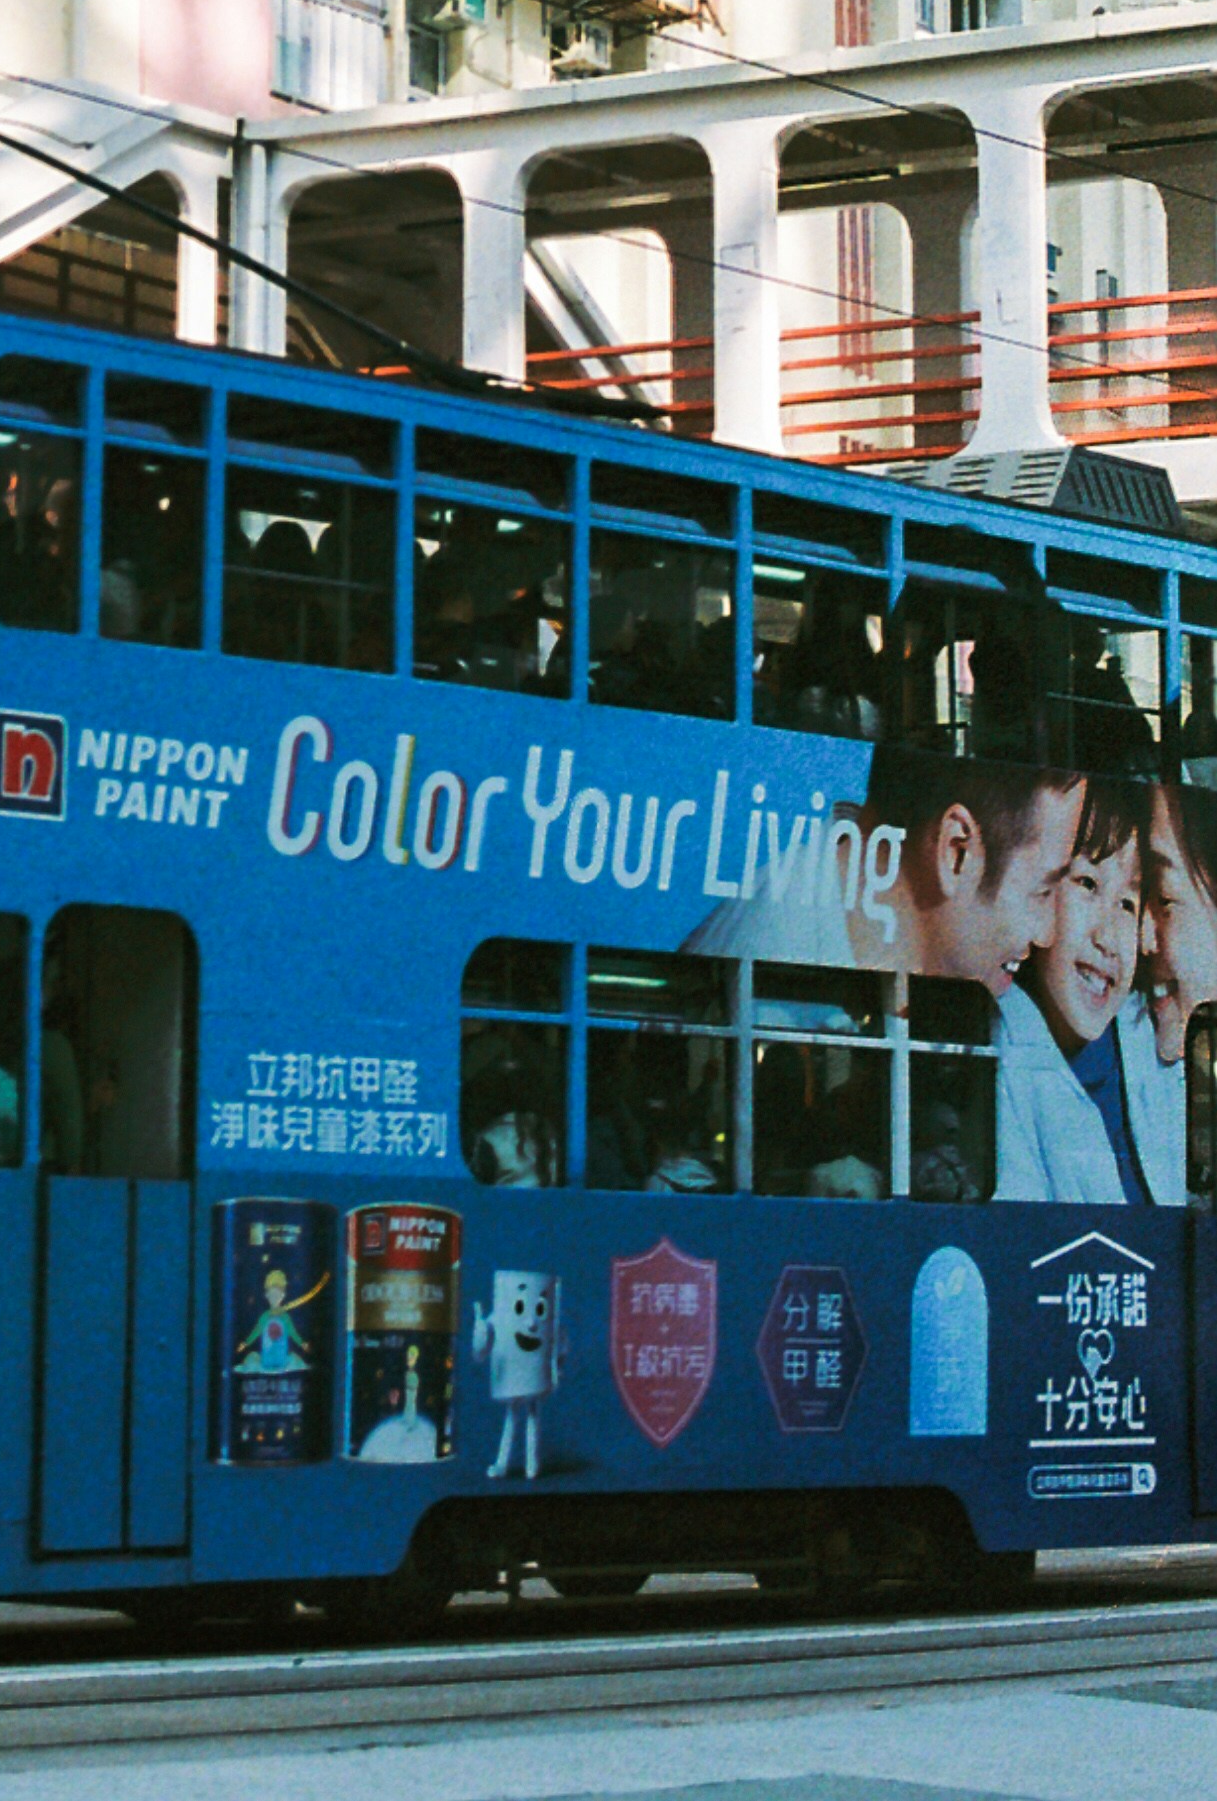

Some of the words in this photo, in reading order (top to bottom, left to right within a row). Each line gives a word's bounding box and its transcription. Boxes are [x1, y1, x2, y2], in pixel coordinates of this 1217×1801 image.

[77, 728, 249, 786] NIPPON
[95, 778, 229, 829] PAINT
[266, 714, 508, 872] Color
[522, 745, 697, 892] Your
[702, 770, 907, 945] Living
[246, 1050, 418, 1104] 立邦抗甲醛
[210, 1101, 448, 1159] 淨味兒童漆系列
[388, 1216, 447, 1236] NIPPON
[394, 1233, 442, 1253] PAINT
[782, 1292, 843, 1332] 分解
[1037, 1273, 1148, 1327] 一份承諾
[782, 1349, 843, 1389] 甲醛
[1036, 1375, 1147, 1432] 十分安心
